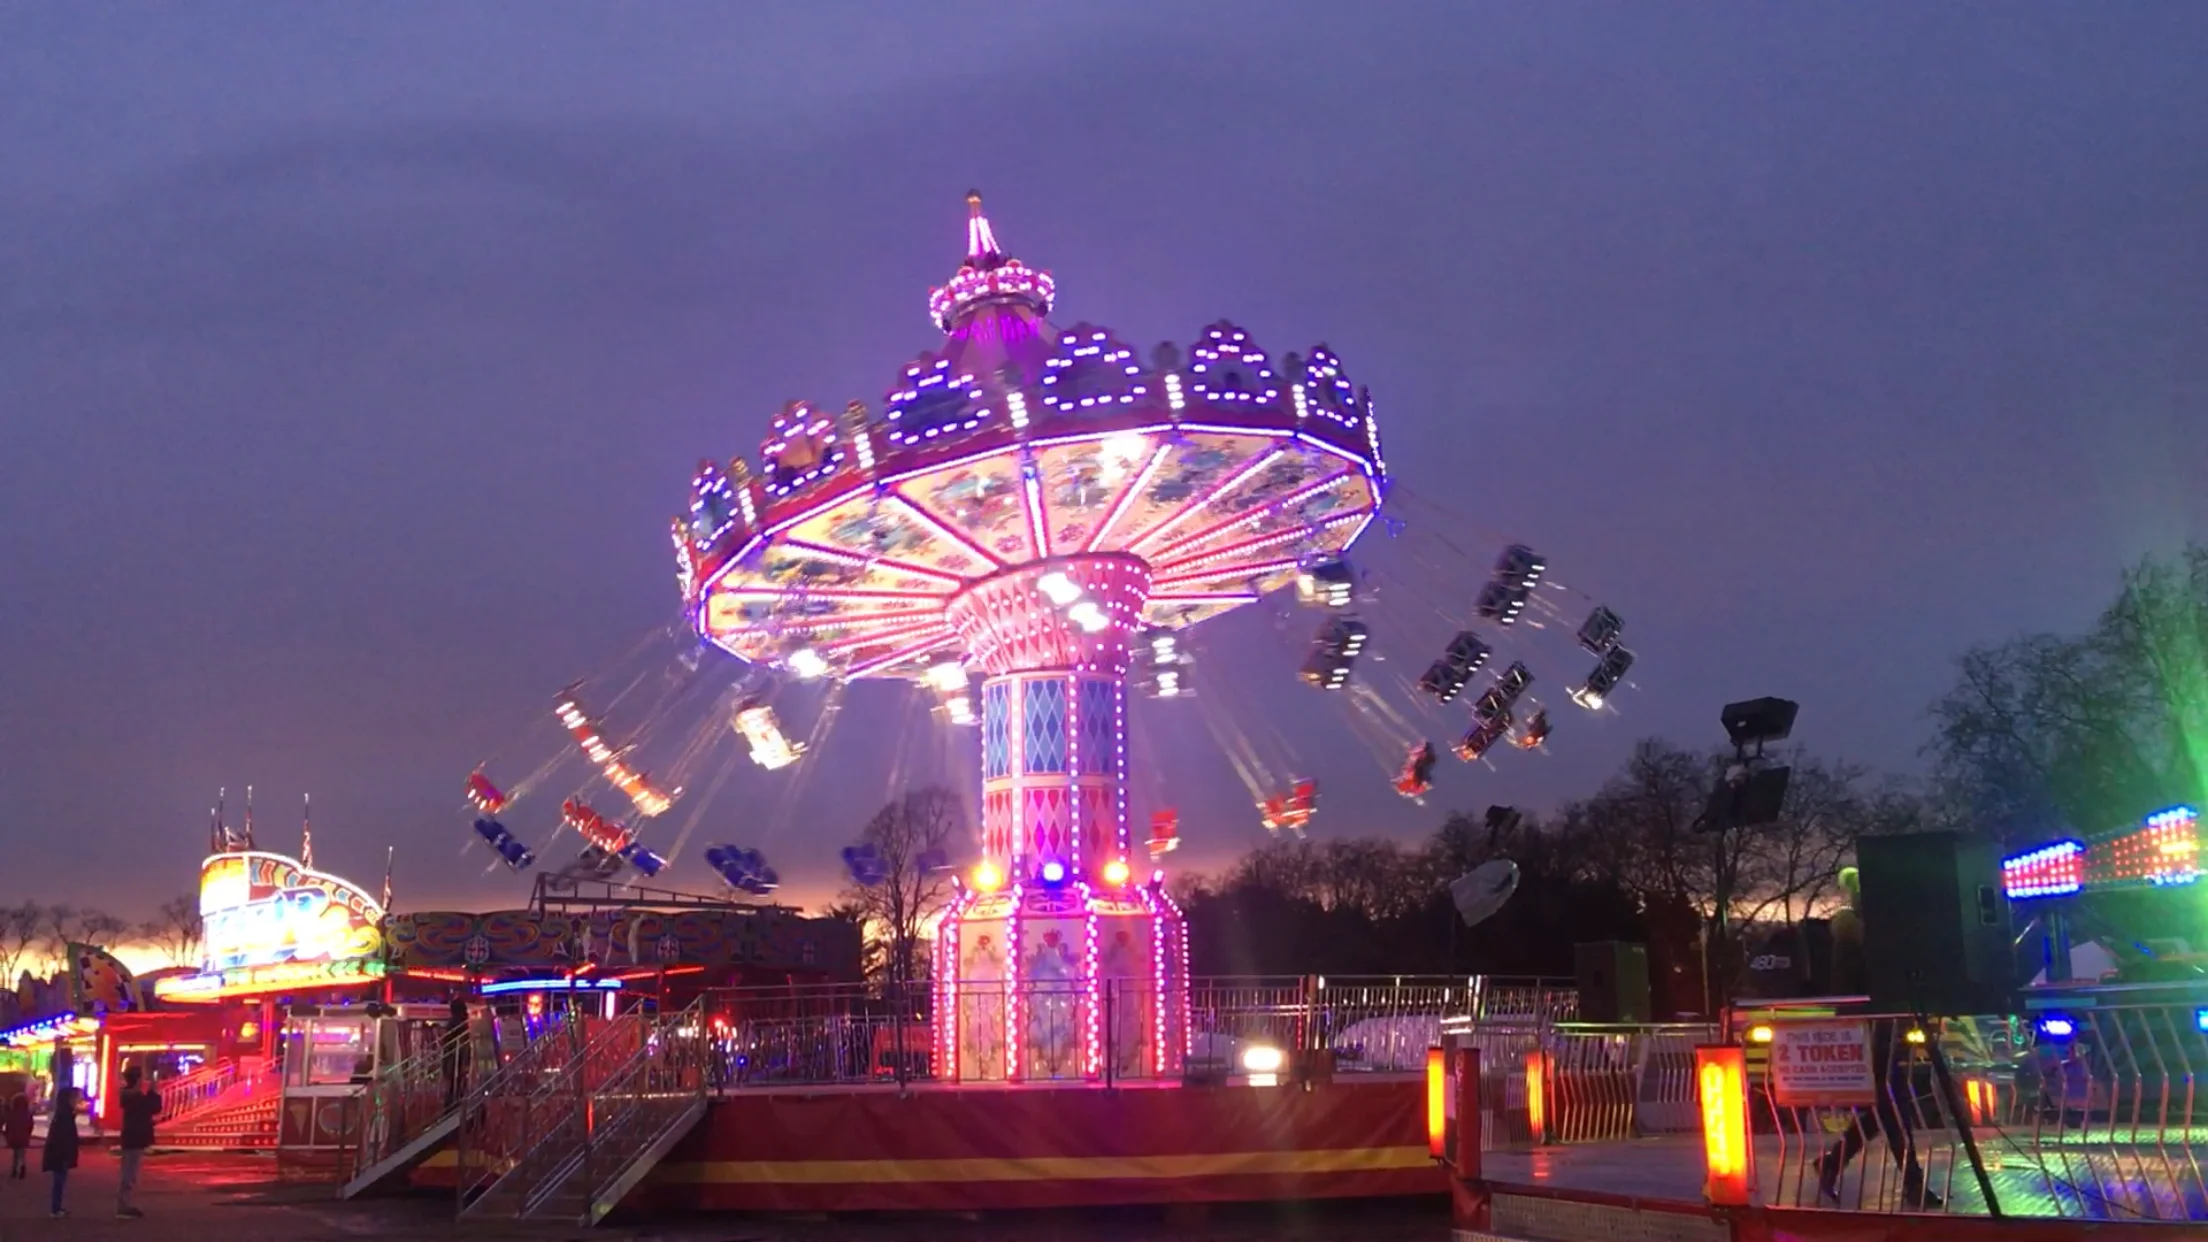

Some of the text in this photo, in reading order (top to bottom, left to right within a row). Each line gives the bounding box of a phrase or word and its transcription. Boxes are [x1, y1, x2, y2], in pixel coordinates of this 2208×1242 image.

[1786, 1030, 1852, 1042] THIS RIDE IS
[1778, 1043, 1864, 1062] 2 TOKEN
[1779, 1063, 1868, 1074] NO CASH ACCEPTED
